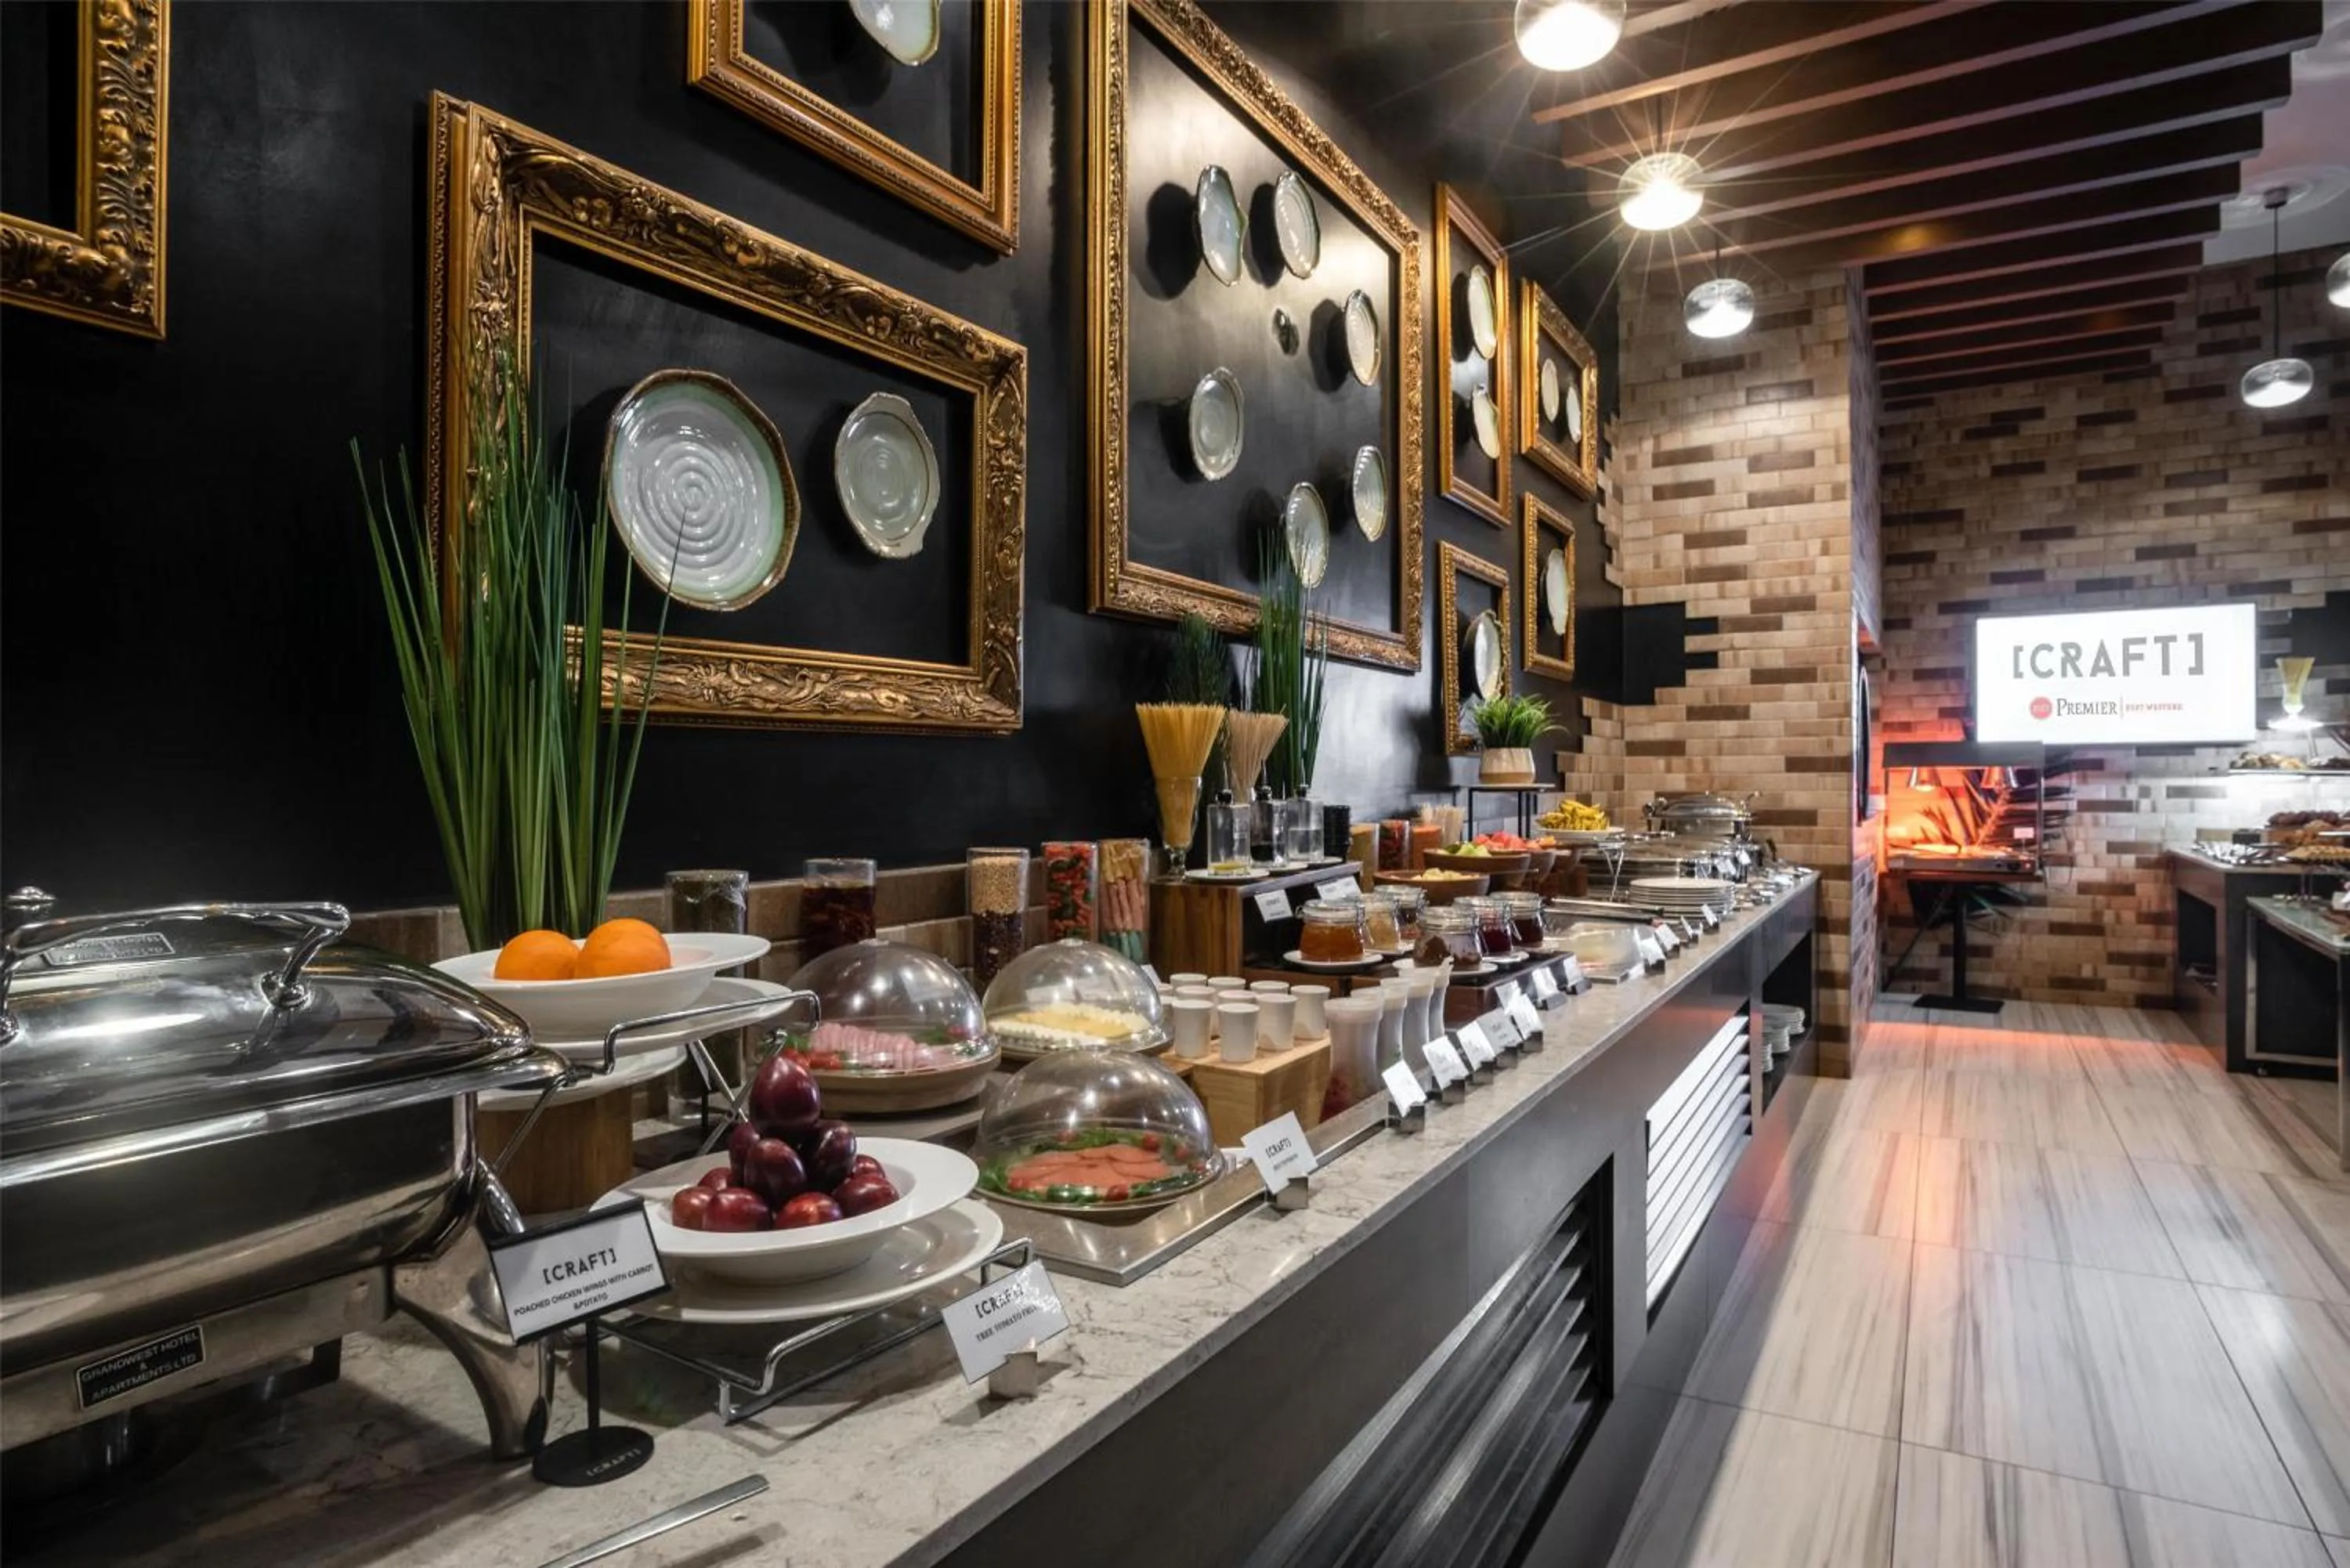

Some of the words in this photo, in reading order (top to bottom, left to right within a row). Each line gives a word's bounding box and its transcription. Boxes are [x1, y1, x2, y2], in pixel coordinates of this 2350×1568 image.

[2012, 632, 2204, 679] [CRAFT]
[2056, 698, 2118, 717] PREMIER
[543, 1248, 616, 1285] [CRAFT]
[513, 1297, 551, 1316] POACHED
[551, 1287, 582, 1304] CHICKEN
[582, 1279, 609, 1293] WINGS
[608, 1273, 627, 1284] WITH
[627, 1263, 654, 1278] CARROT
[81, 1345, 159, 1382] GRANDWEST
[161, 1331, 199, 1353] HOTEL
[174, 1353, 197, 1368] LTD
